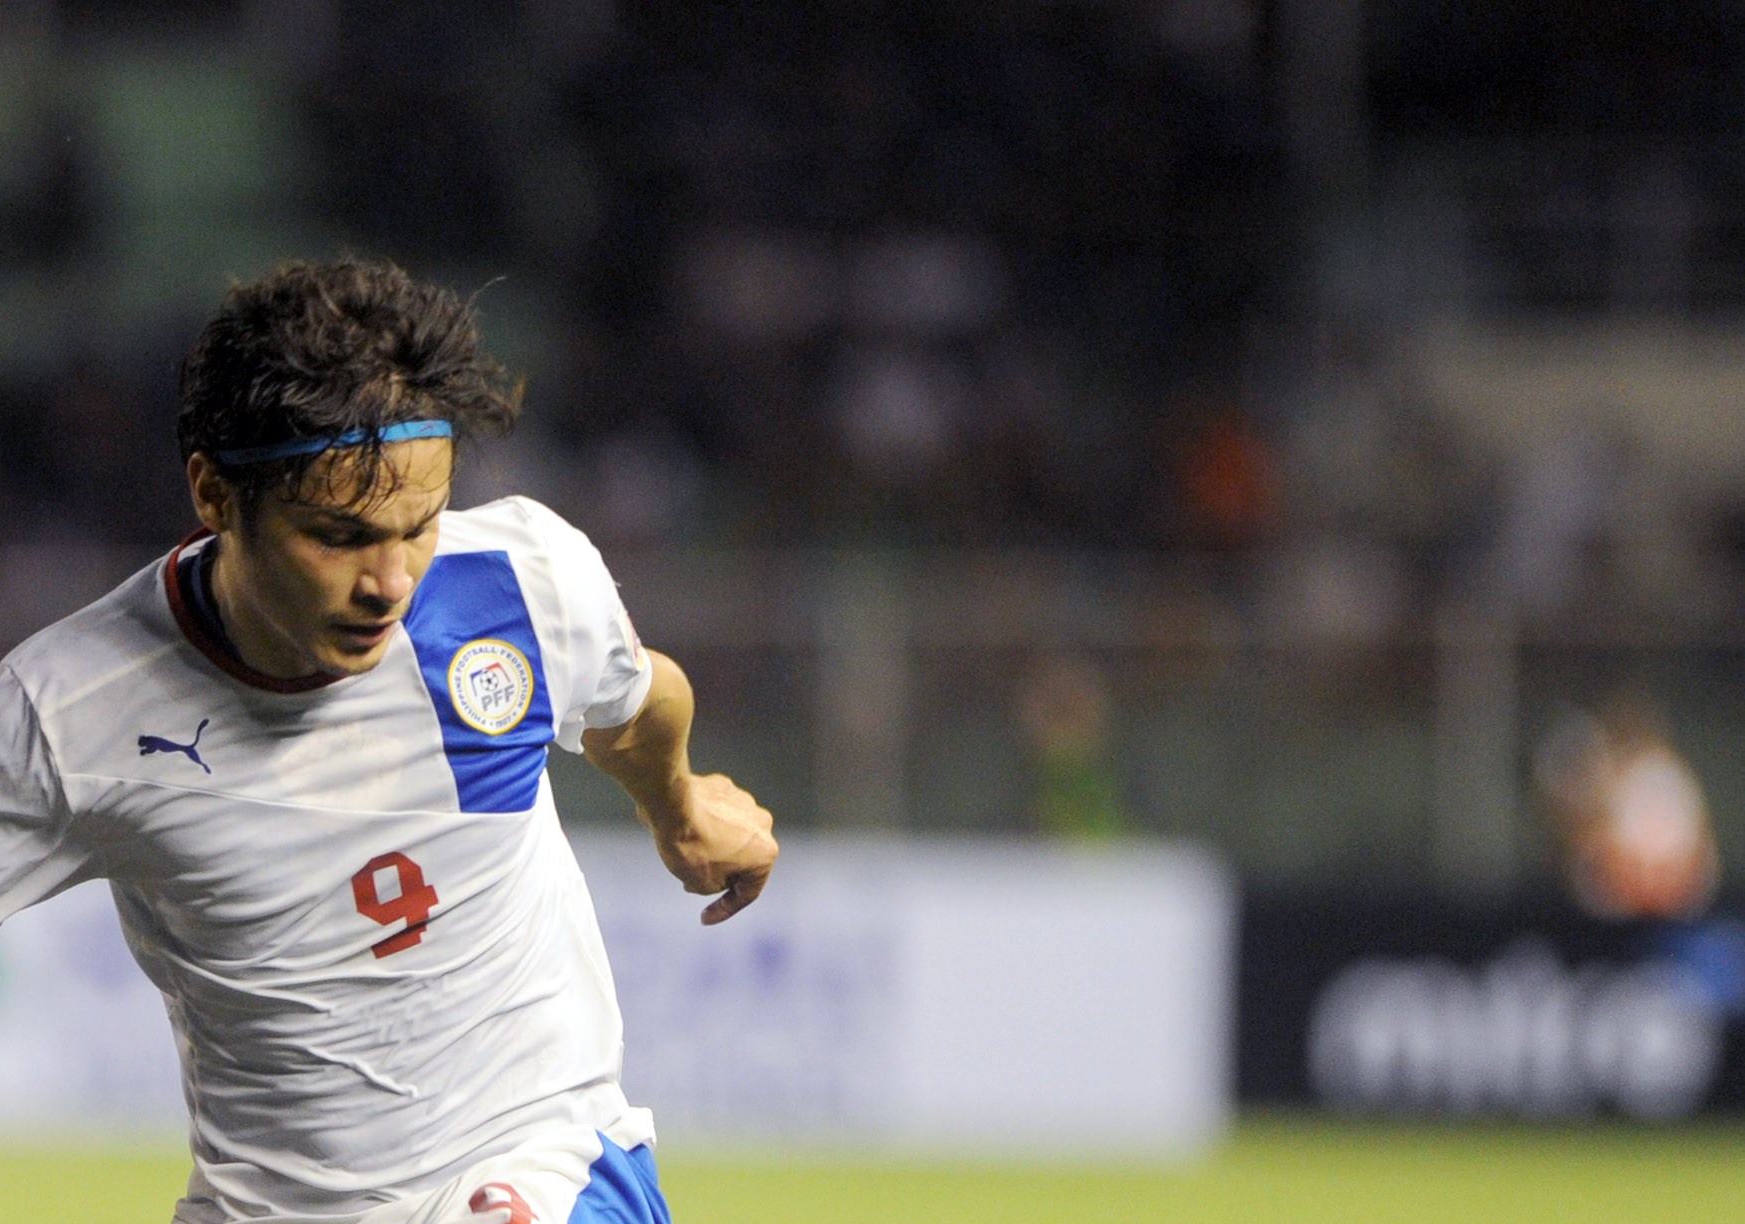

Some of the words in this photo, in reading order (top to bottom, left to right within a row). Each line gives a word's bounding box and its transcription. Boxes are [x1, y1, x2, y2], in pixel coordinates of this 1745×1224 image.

[455, 646, 498, 673] FOOTBALL
[500, 649, 528, 708] FEDERATION
[481, 684, 514, 711] PFF
[351, 851, 439, 960] 9
